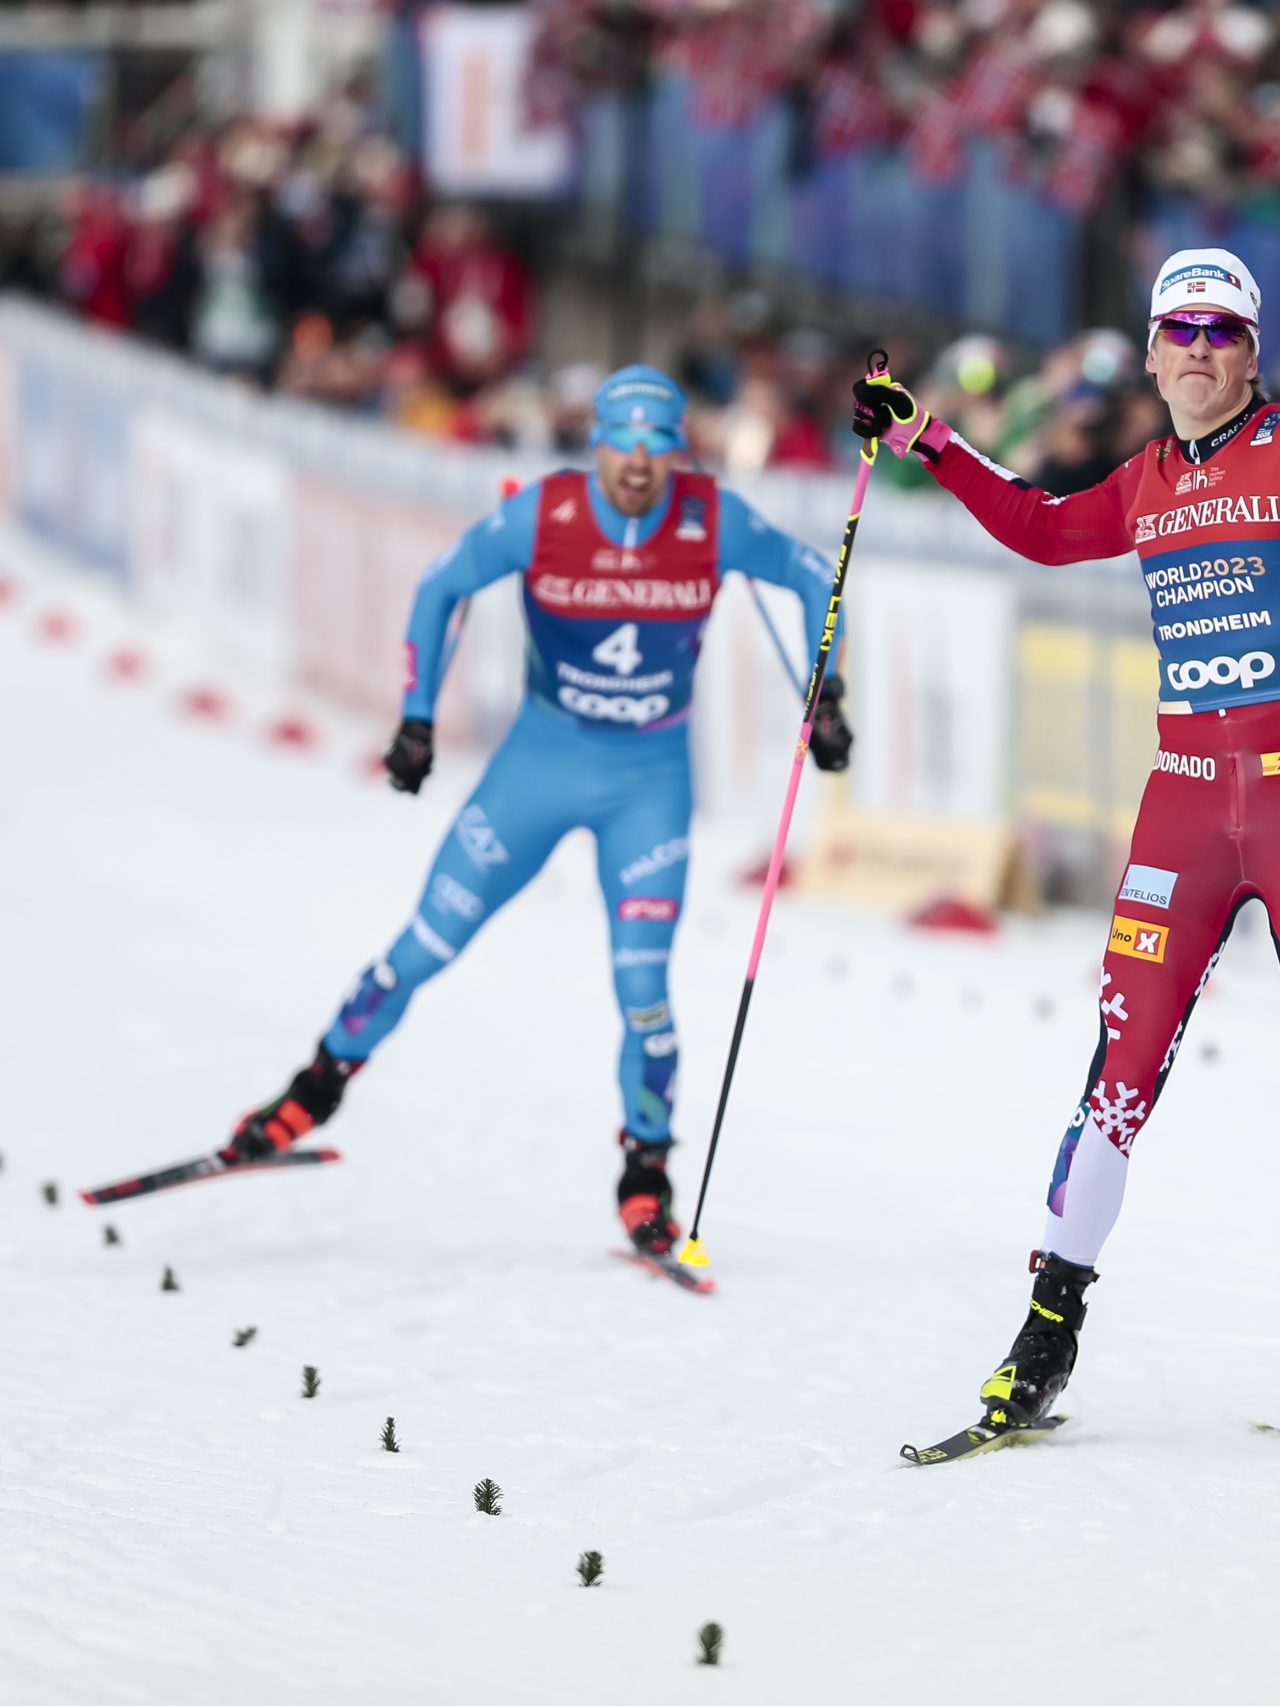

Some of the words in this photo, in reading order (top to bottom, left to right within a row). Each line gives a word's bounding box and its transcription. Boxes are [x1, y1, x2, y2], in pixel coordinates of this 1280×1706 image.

[1161, 267, 1225, 291] SpareBank
[572, 578, 712, 610] GENERALI
[1155, 576, 1255, 608] CHAMPION
[819, 594, 841, 651] LEKI
[1158, 610, 1272, 641] TRONDHEIM
[592, 622, 643, 677] 4
[1167, 650, 1276, 691] coop
[557, 686, 670, 726] coop
